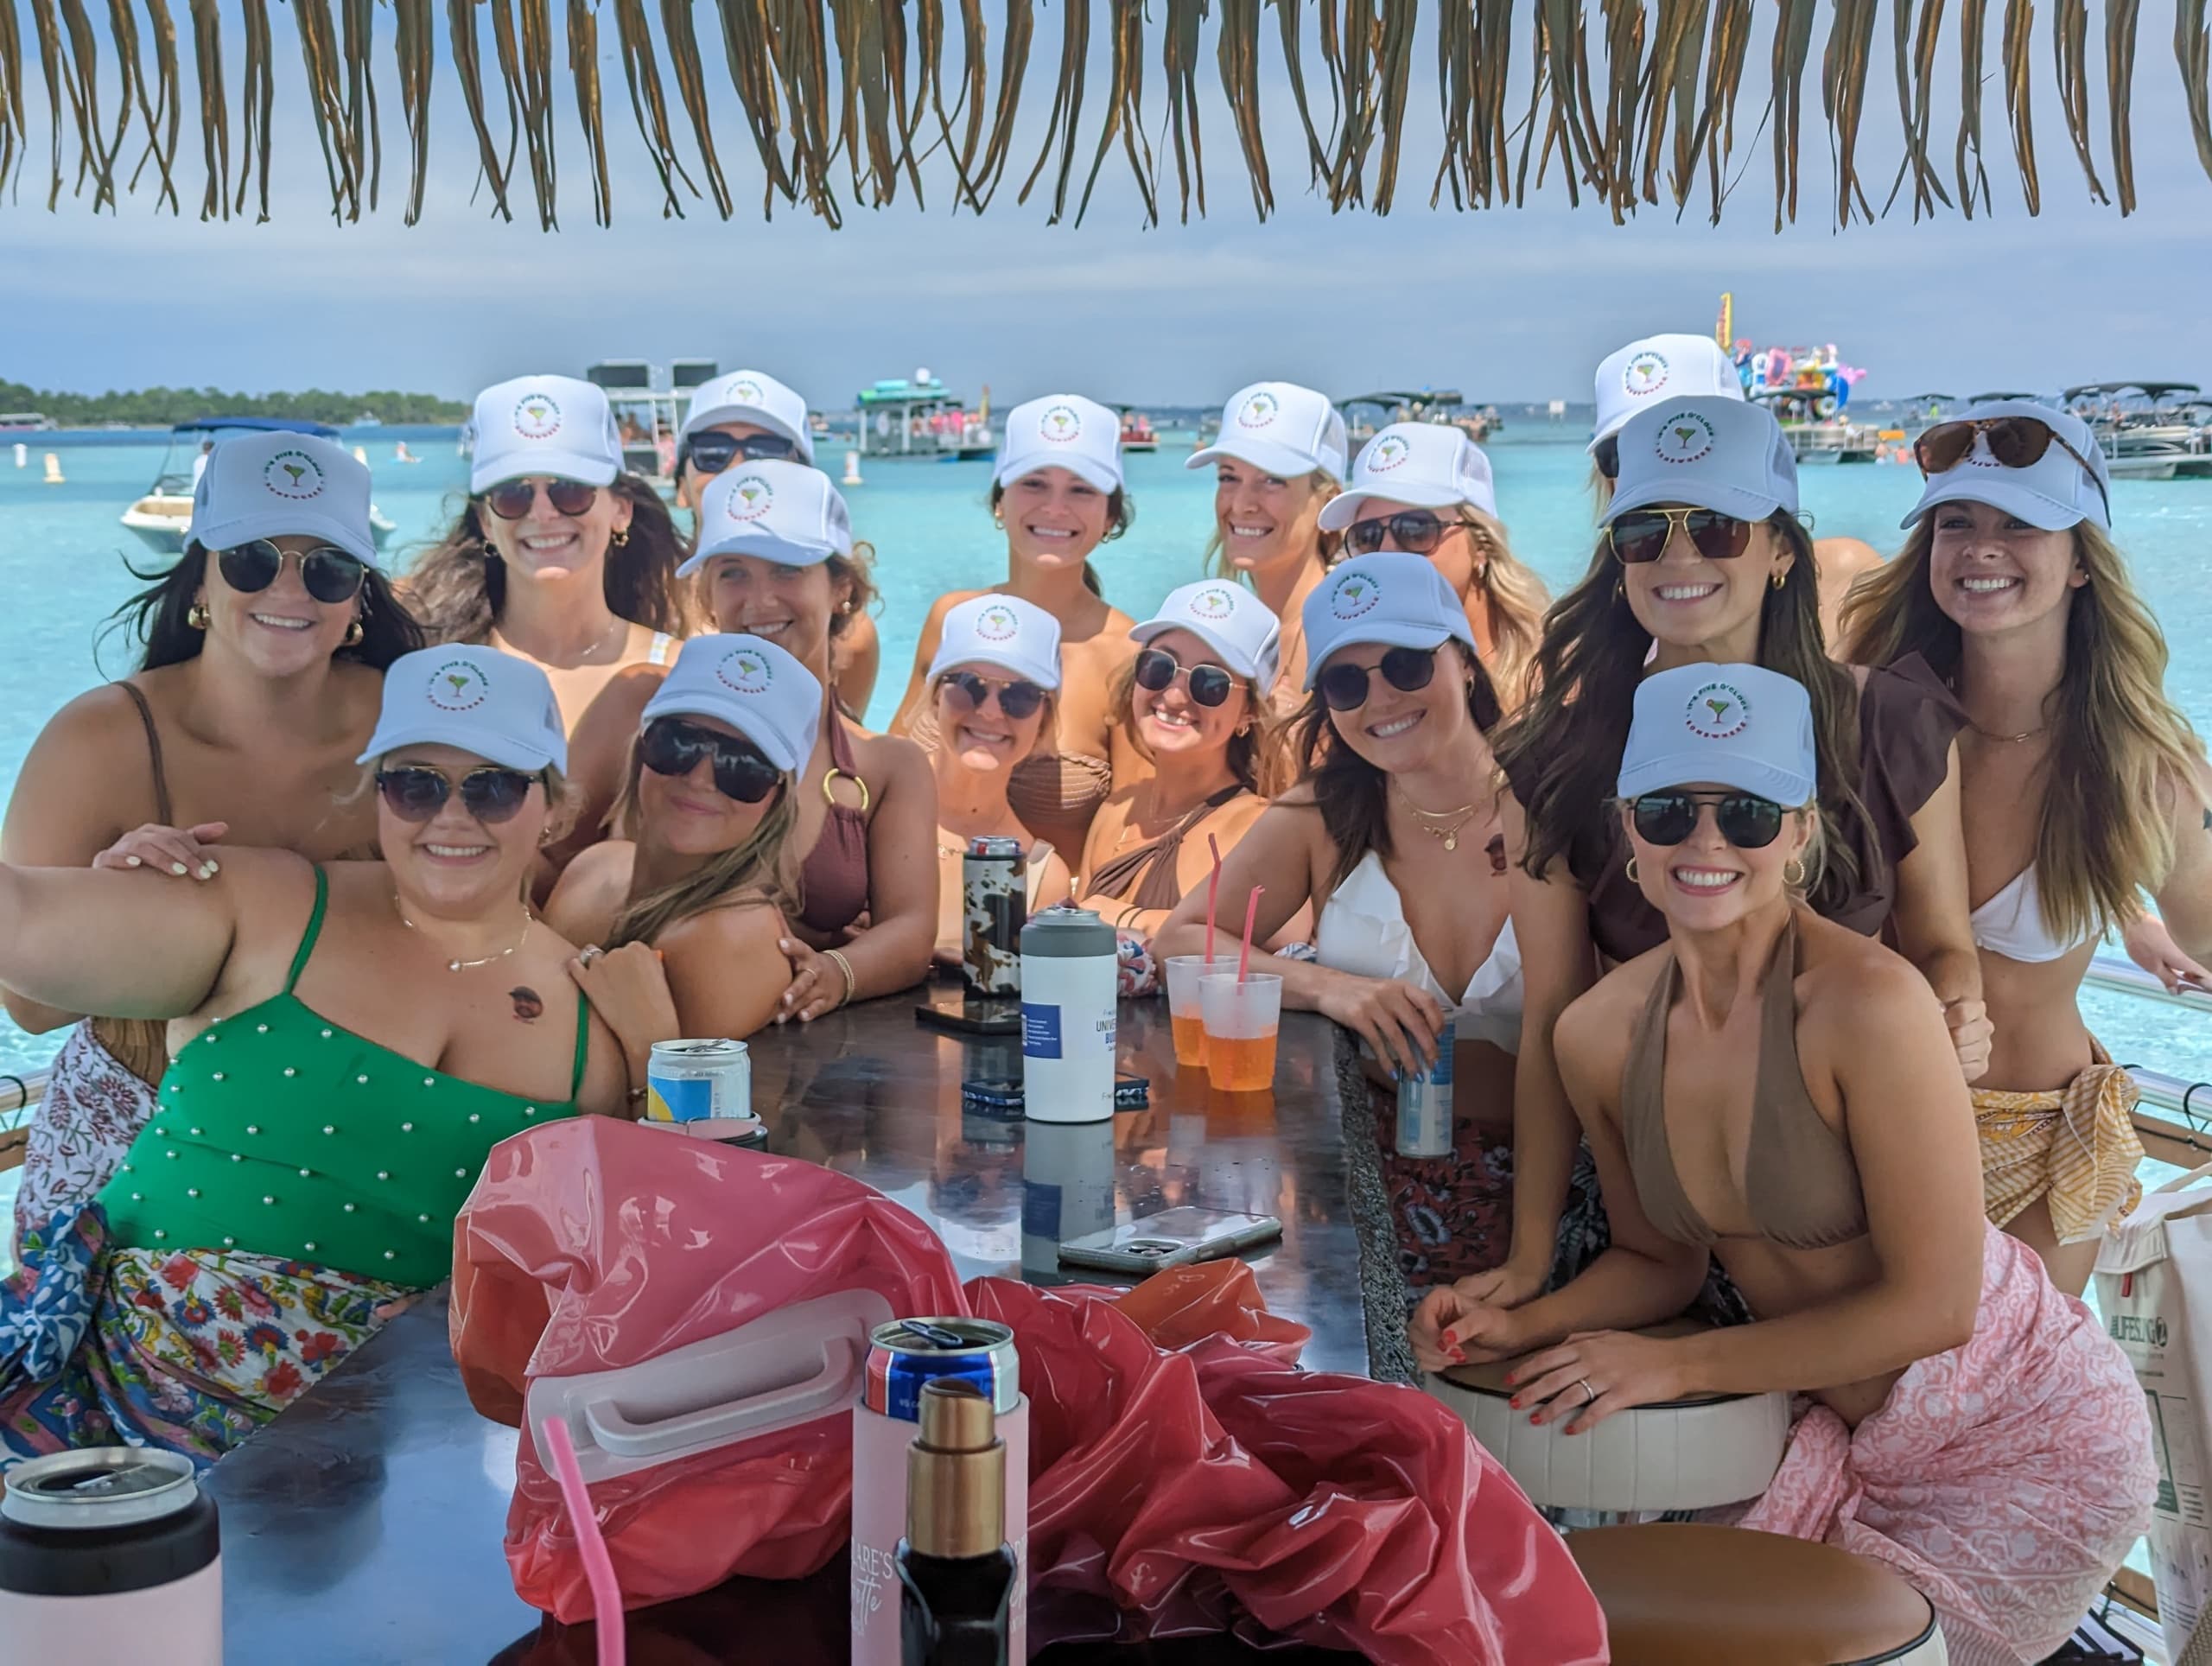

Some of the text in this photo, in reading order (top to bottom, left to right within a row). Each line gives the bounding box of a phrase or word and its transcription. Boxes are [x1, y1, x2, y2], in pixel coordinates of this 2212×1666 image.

[1668, 413, 1685, 425] FIVE
[1688, 412, 1714, 437] O'CLOCK
[1698, 683, 1717, 695] FIVE
[1719, 683, 1747, 710] O'CLOCK
[1686, 720, 1746, 739] SOMEWHERE
